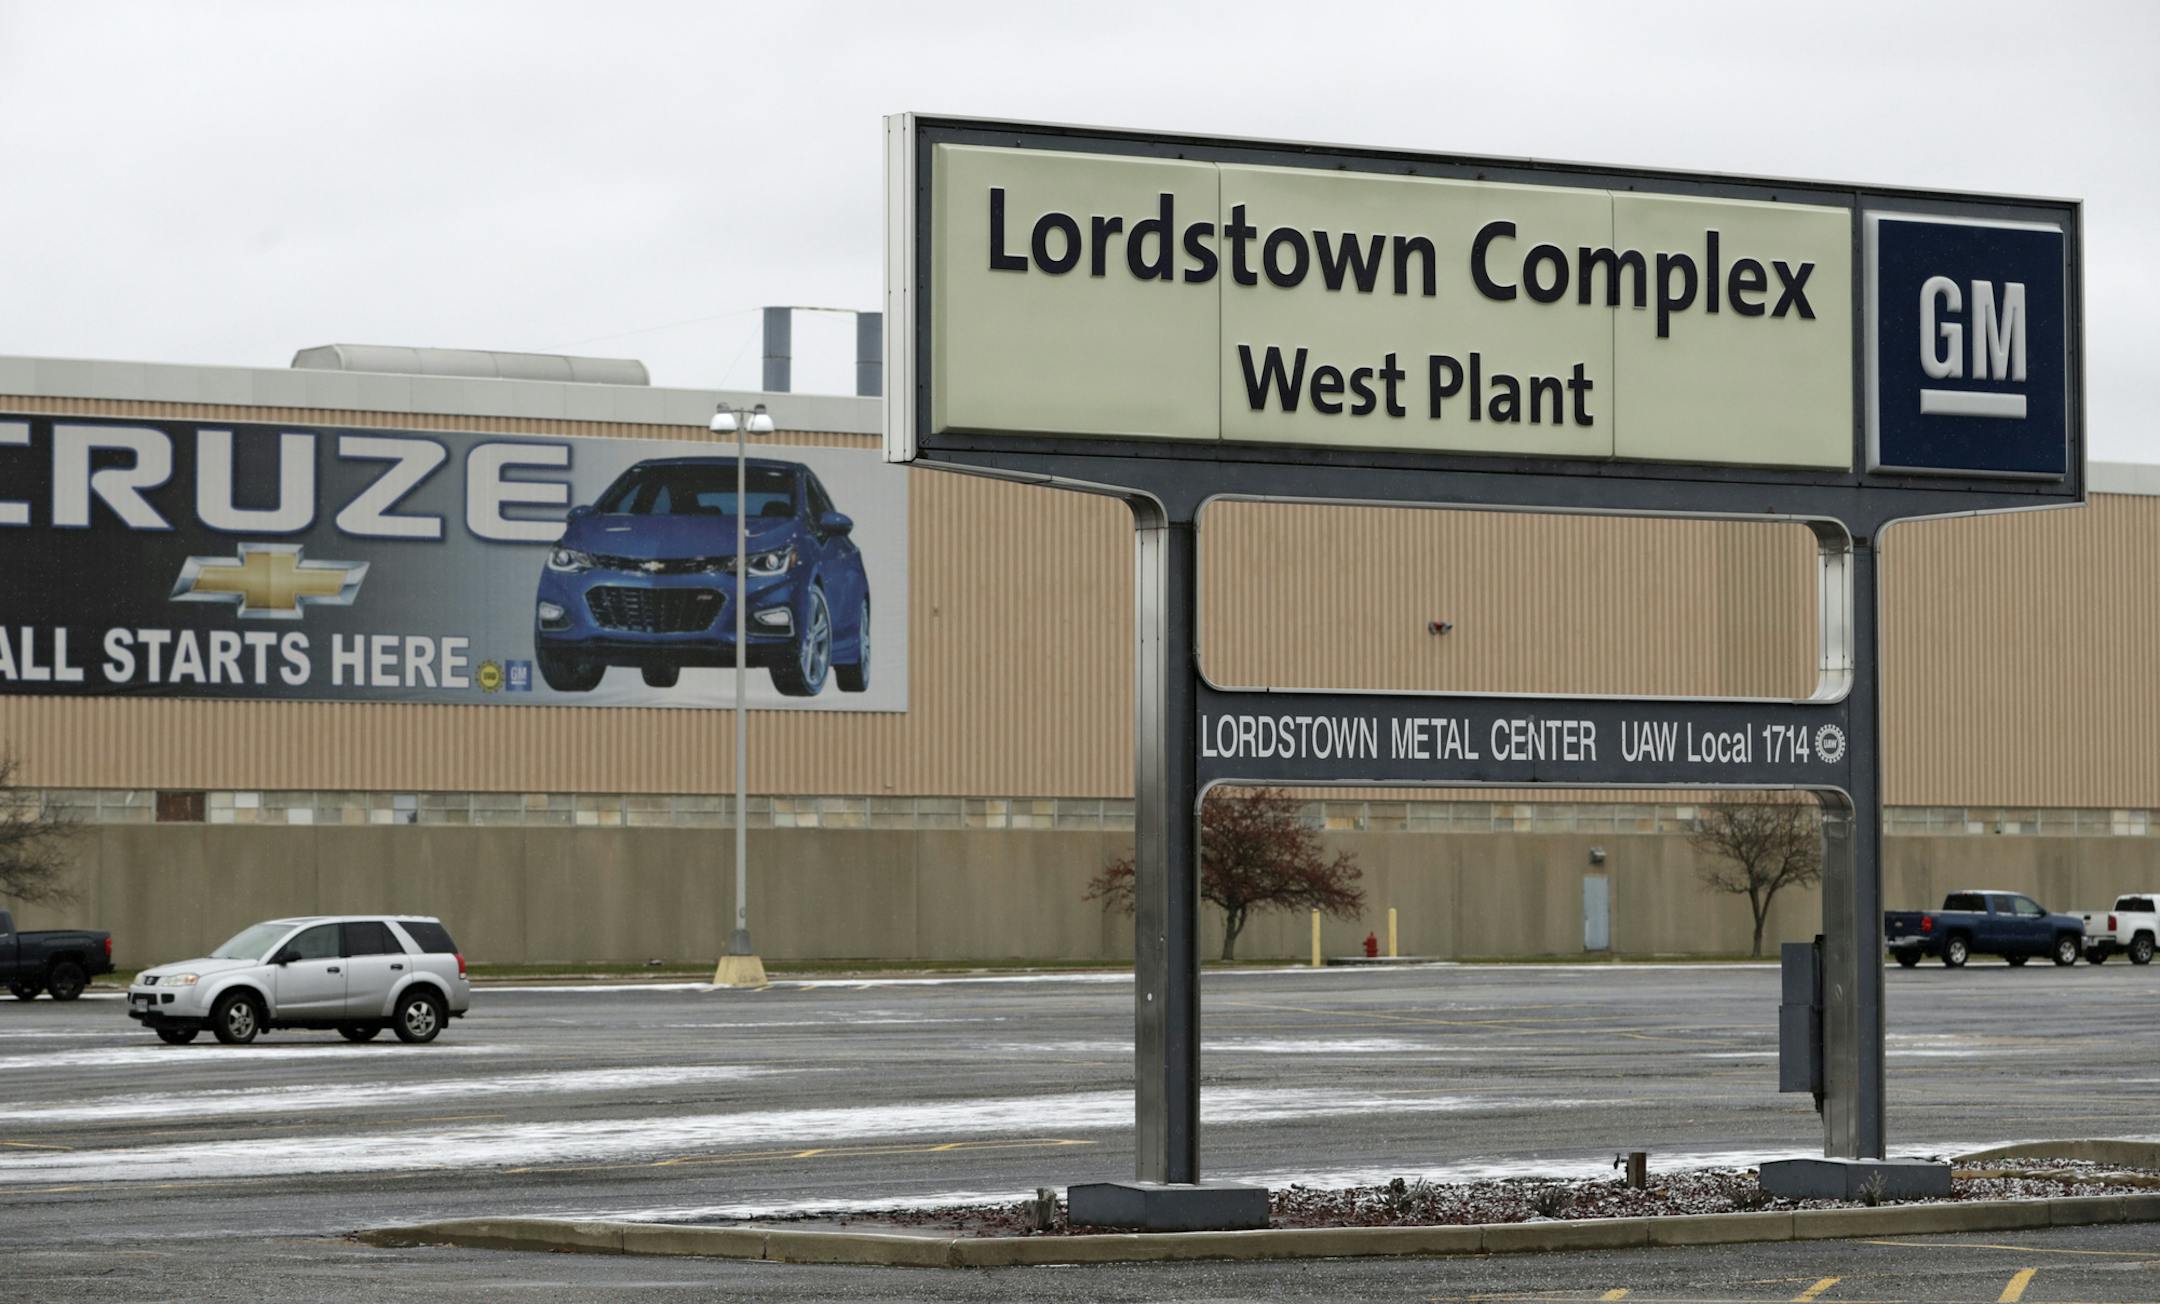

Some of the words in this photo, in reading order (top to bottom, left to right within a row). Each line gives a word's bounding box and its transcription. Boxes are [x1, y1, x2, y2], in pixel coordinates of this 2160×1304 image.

[990, 188, 1436, 297] Lordstown
[1471, 221, 1816, 338] Complex
[1920, 275, 2027, 382] GM
[1238, 345, 1406, 418] West
[1429, 351, 1594, 426] Plant
[102, 627, 311, 687] STARTS
[332, 633, 470, 688] HERE
[1202, 714, 1377, 759] LORDSTOWN
[1392, 717, 1479, 760] METAL
[1491, 718, 1597, 761] CENTER
[1621, 720, 1678, 762] UAW
[1687, 722, 1751, 763] Local
[1762, 724, 1809, 763] 1714
